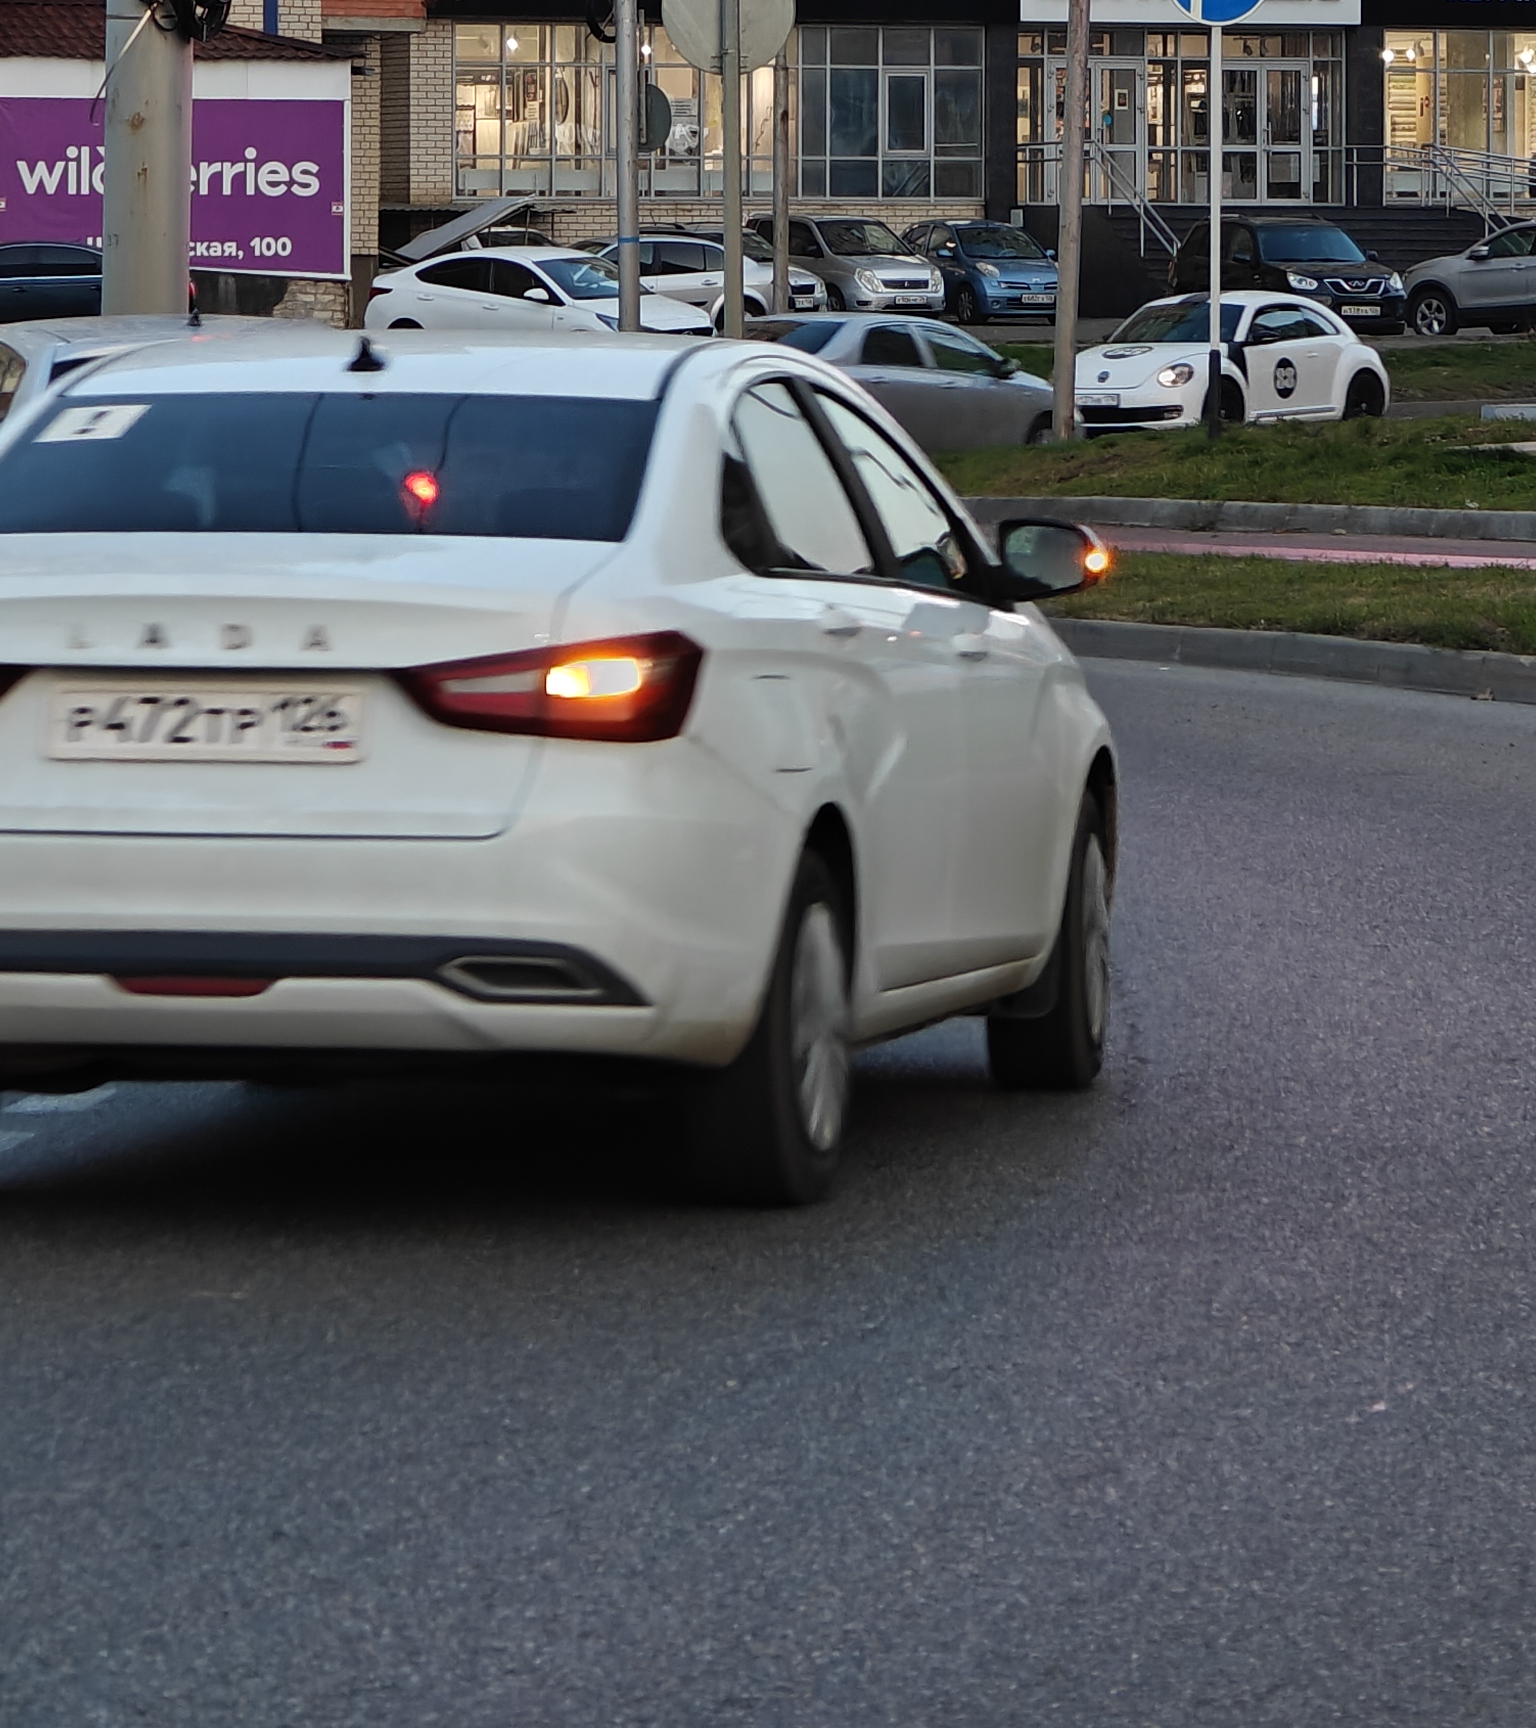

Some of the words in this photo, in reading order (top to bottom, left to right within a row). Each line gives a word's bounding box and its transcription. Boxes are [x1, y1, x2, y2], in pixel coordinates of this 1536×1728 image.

[16, 145, 320, 196] wilrries
[249, 237, 292, 257] 100
[68, 622, 332, 651] LADA
[67, 695, 256, 745] Р472ТР
[272, 694, 348, 733] 126
